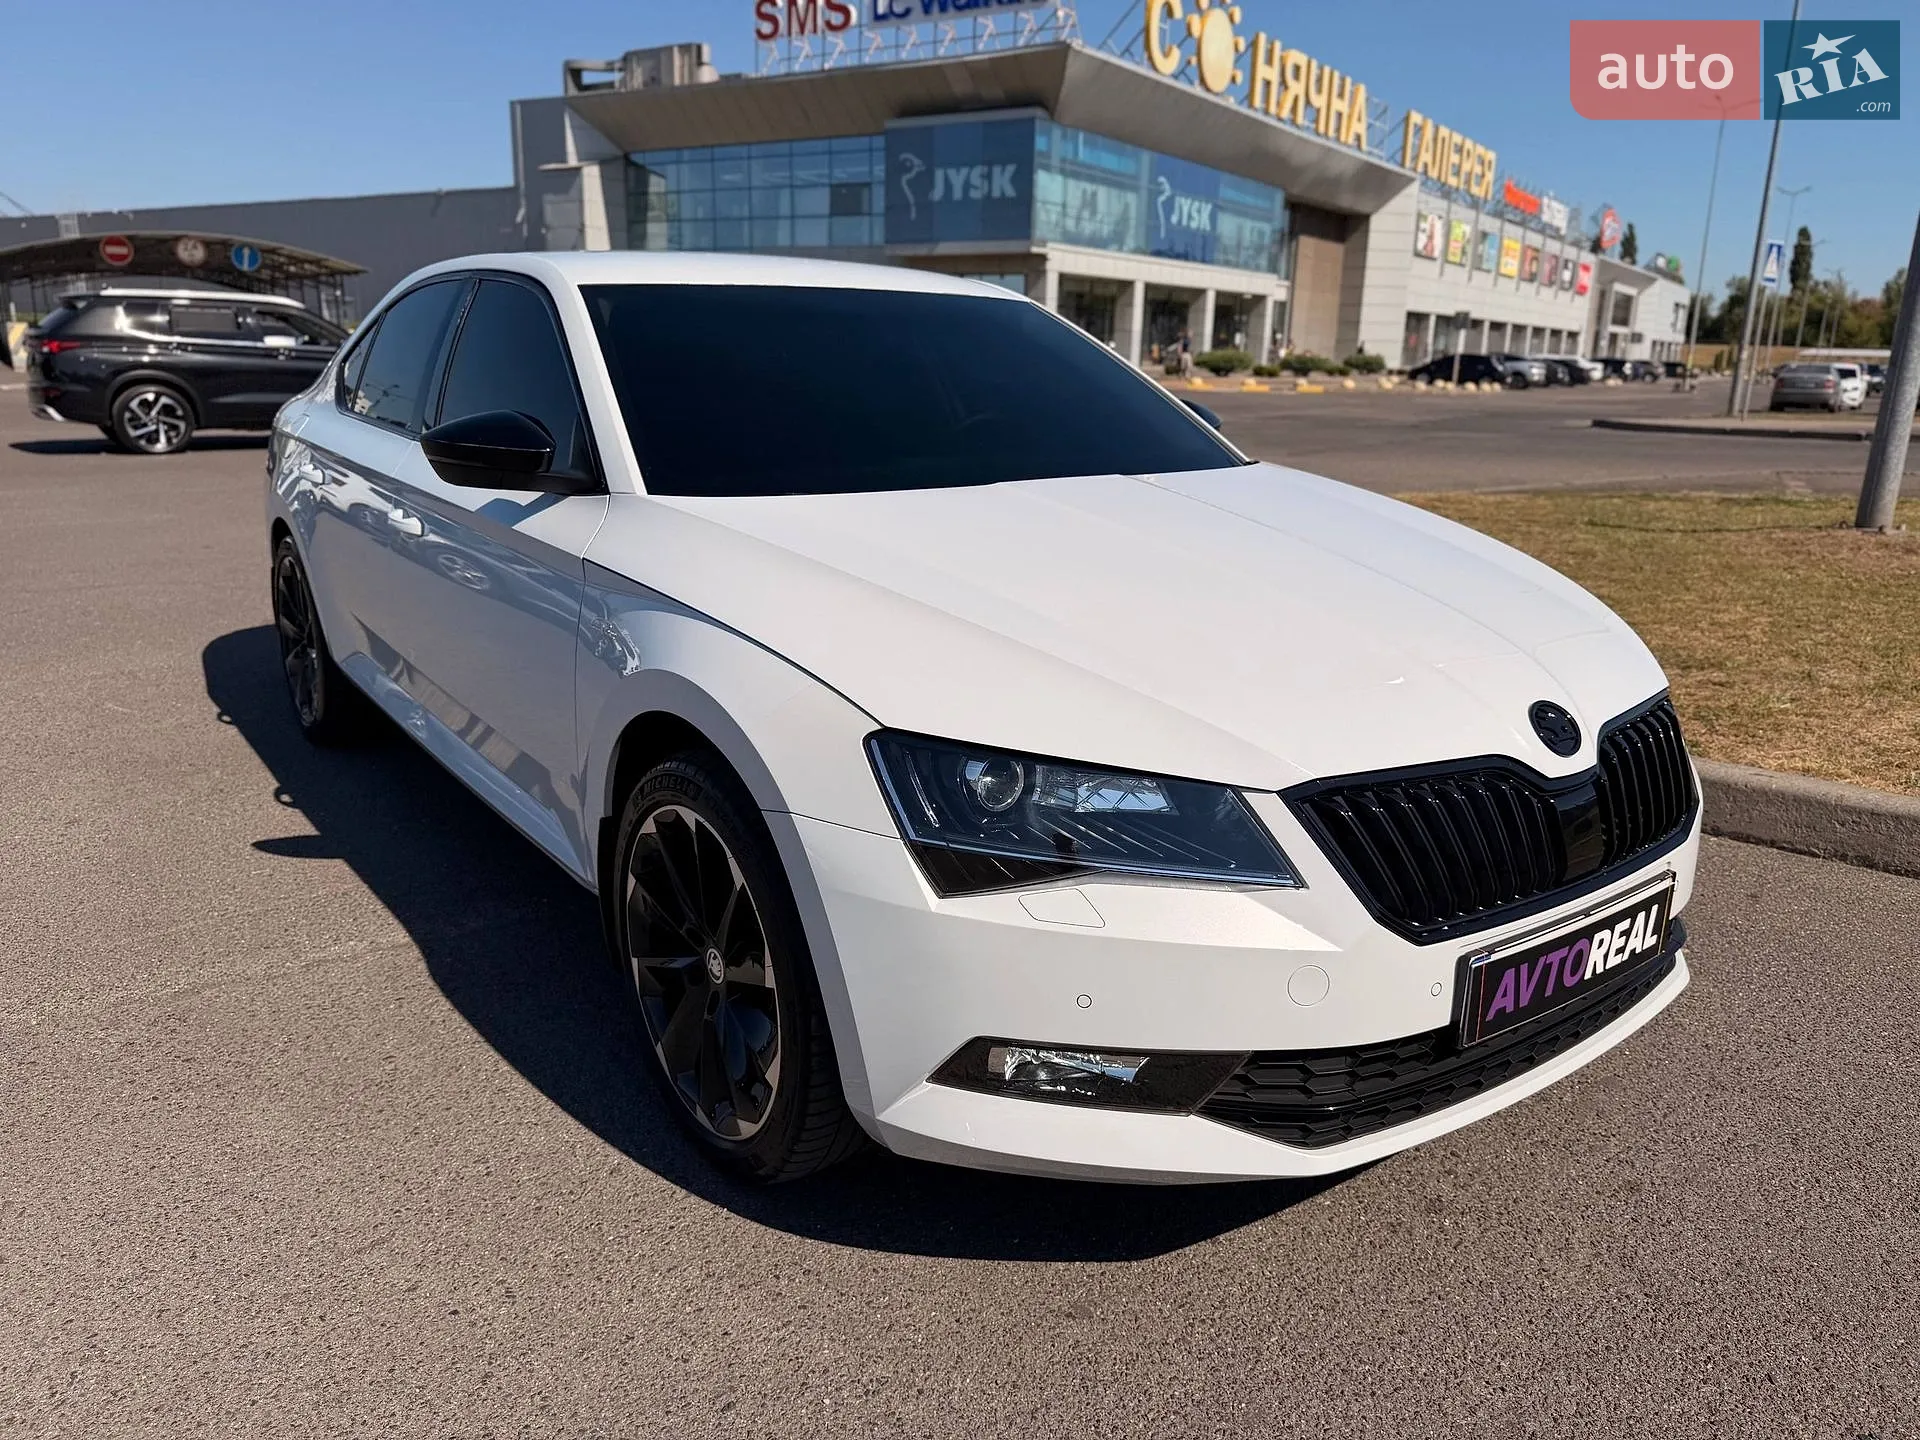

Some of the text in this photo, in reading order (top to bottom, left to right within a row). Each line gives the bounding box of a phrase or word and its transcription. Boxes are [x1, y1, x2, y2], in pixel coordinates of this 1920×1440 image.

[755, 0, 853, 41] SMS
[1403, 109, 1497, 200] ГАЛЕРЕЯ
[928, 164, 1018, 202] JYSK
[1170, 196, 1213, 231] JYSK
[1486, 904, 1659, 1022] AVTOREAL
